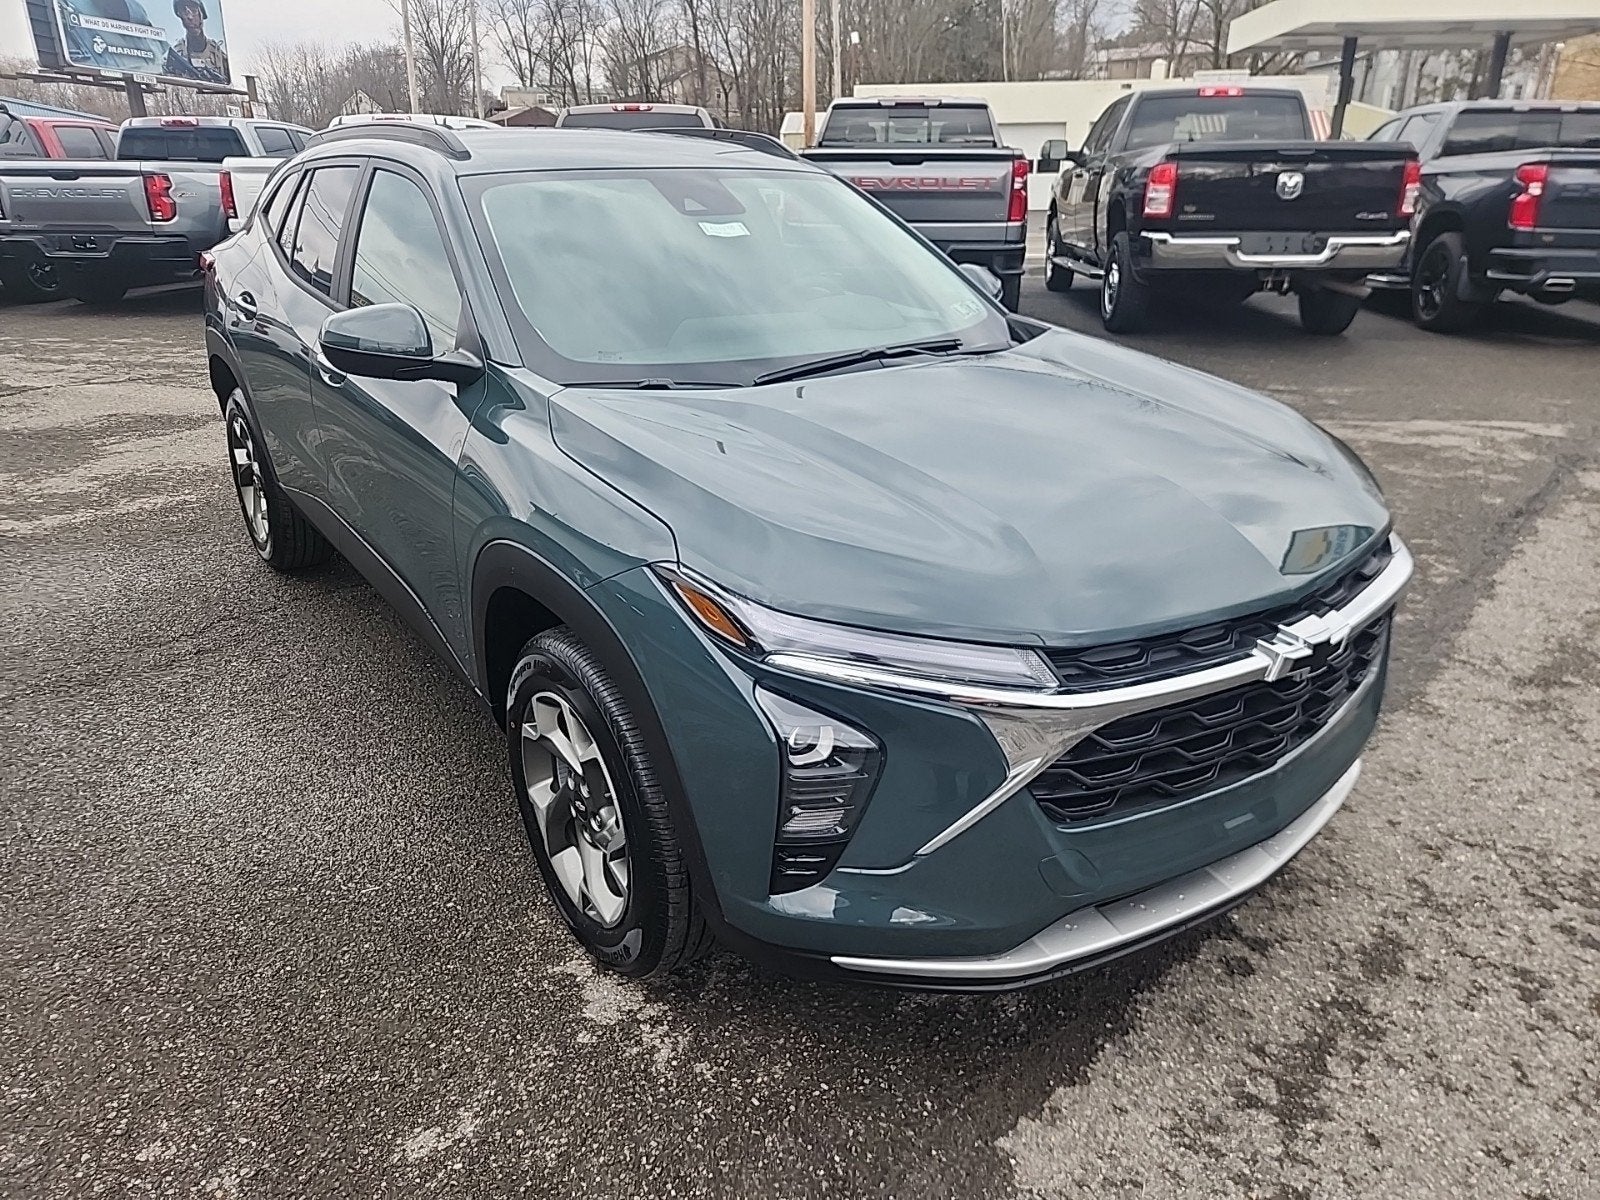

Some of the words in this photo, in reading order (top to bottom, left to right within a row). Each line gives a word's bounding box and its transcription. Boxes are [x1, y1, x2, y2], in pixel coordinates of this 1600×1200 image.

[110, 22, 134, 33] MARINES
[134, 27, 149, 35] FIGHT
[107, 46, 154, 59] MARINES
[10, 187, 127, 199] CHEVROLET
